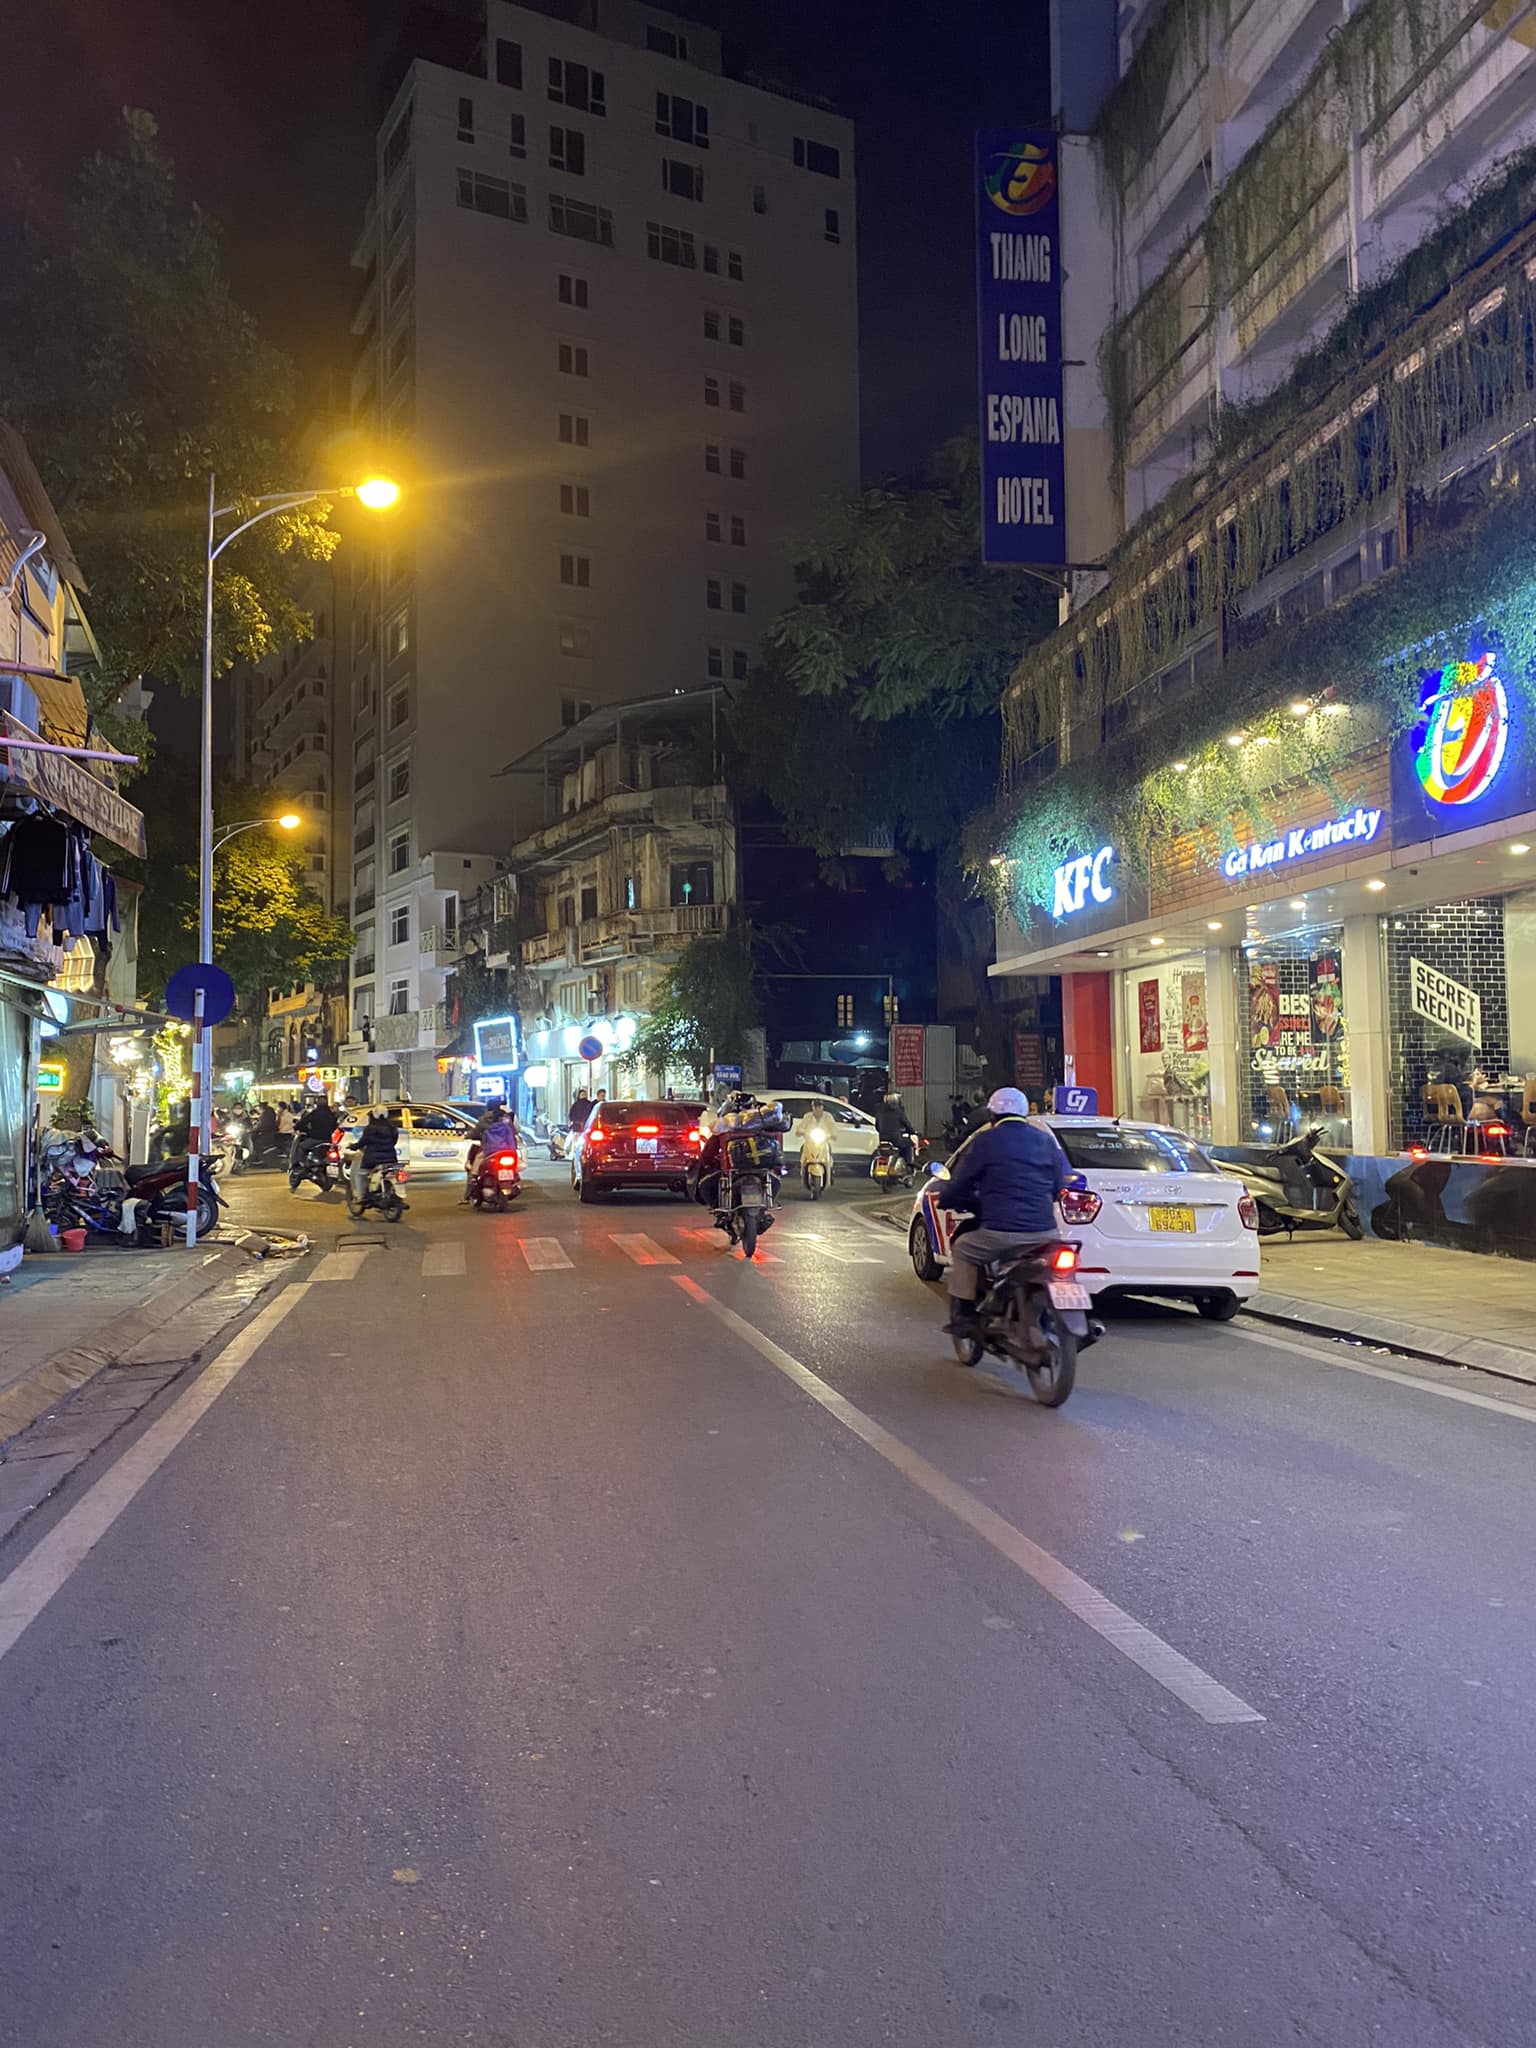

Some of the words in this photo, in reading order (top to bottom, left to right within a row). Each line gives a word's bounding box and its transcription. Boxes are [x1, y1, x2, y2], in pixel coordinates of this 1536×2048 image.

[990, 233, 1051, 283] THANG
[998, 313, 1047, 363] LONG
[987, 394, 1060, 445] ESPANA
[997, 476, 1055, 526] HOTEL
[1287, 808, 1382, 859] Kentucky
[1052, 846, 1113, 918] KFC
[1416, 966, 1475, 1017] SECRET
[1416, 985, 1476, 1041] RECIPE
[1067, 1090, 1089, 1112] G7
